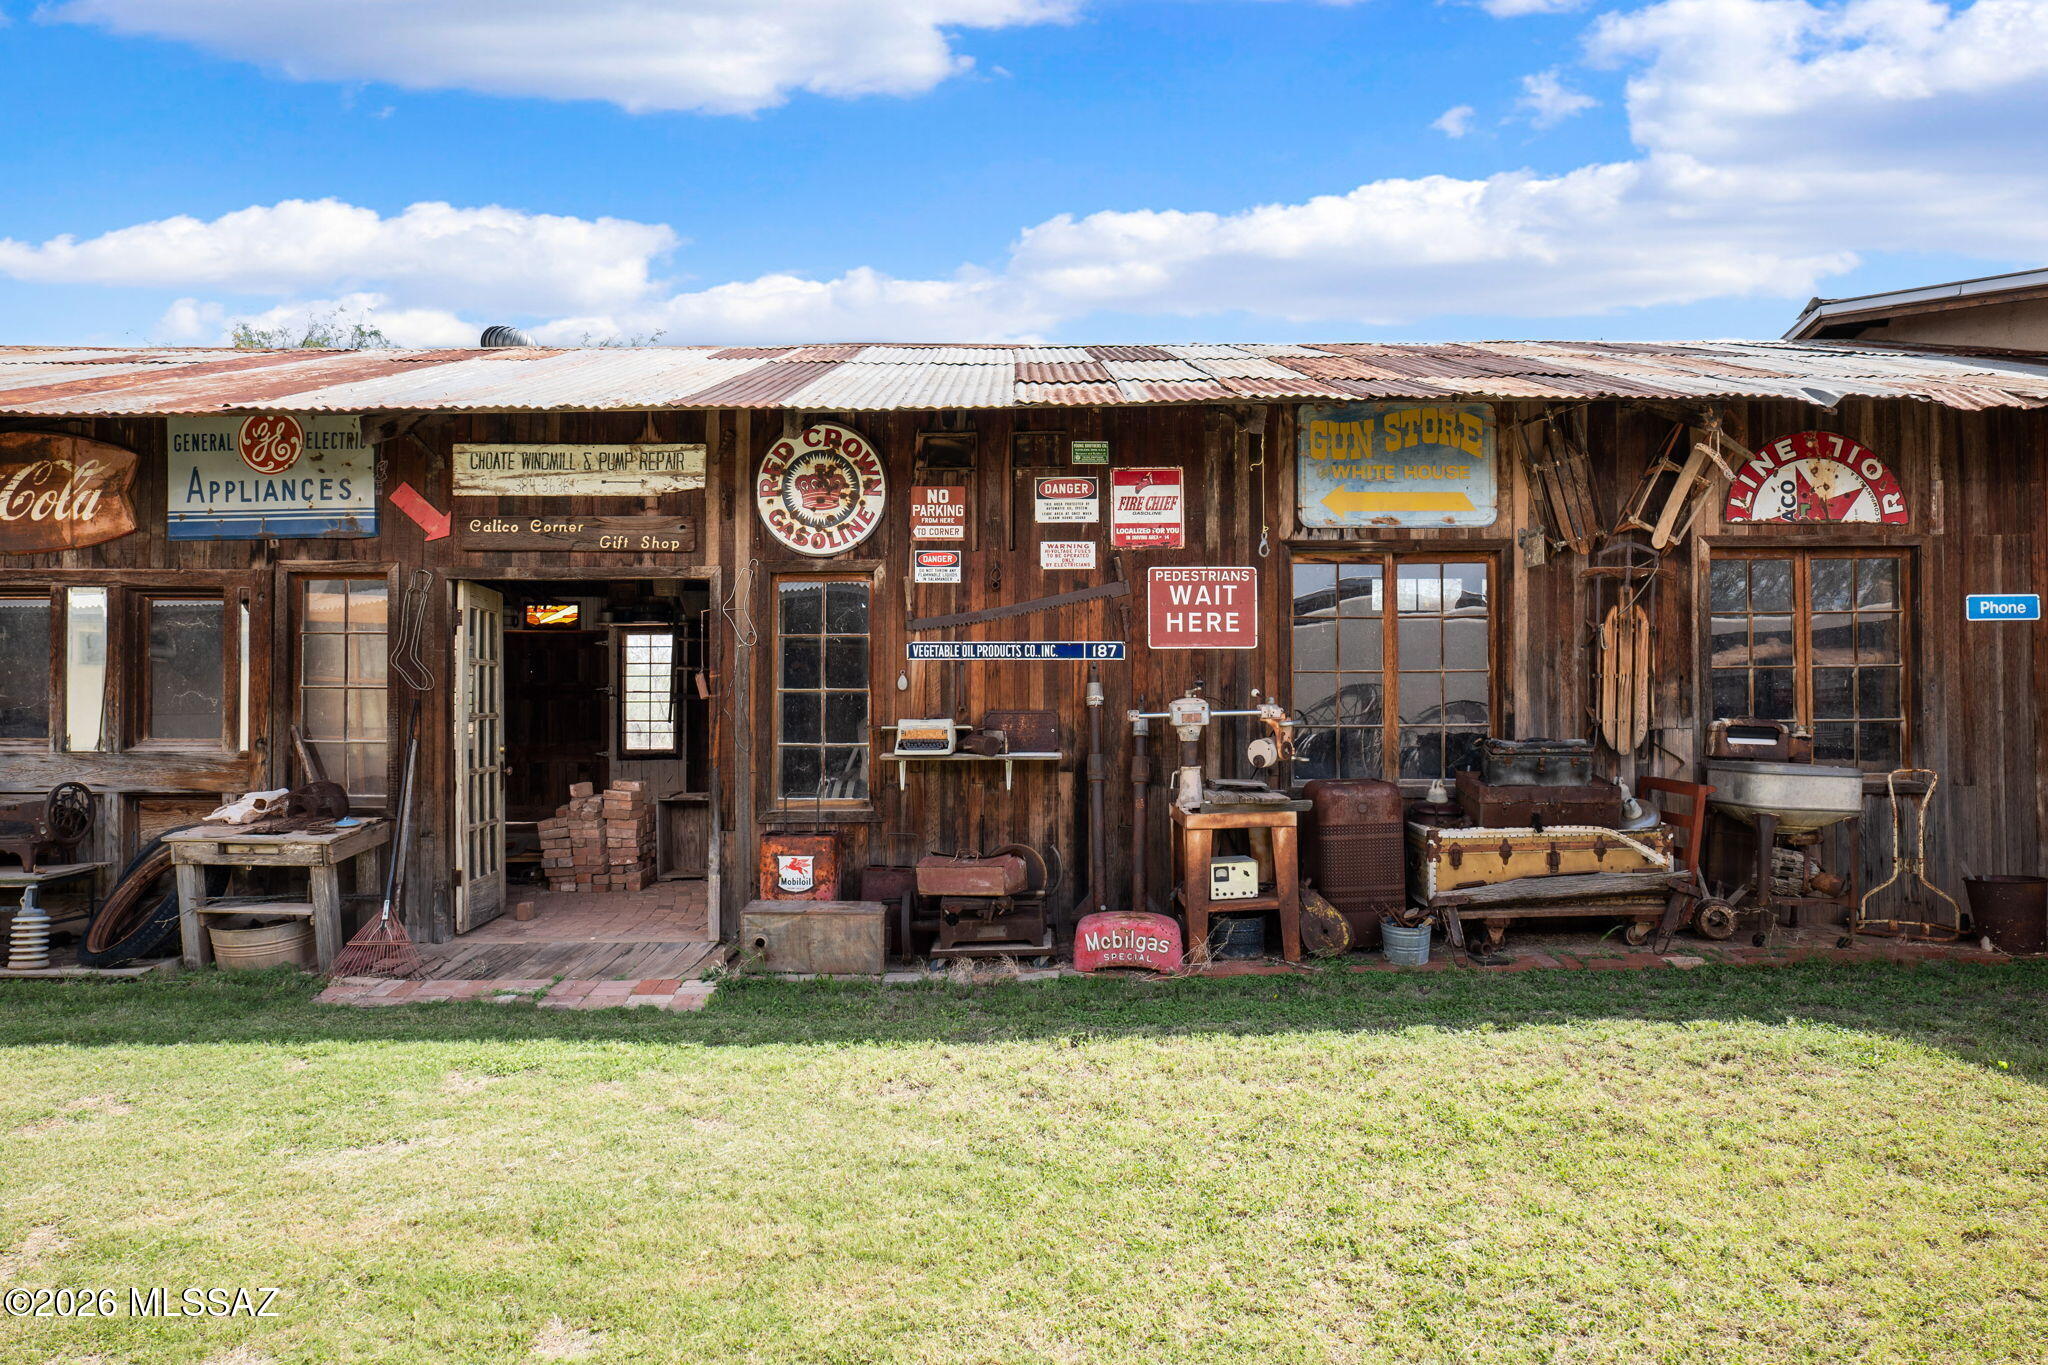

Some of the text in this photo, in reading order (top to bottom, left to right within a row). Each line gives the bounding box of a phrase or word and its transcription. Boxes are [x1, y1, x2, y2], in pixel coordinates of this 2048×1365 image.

[252, 421, 292, 462] GE
[1310, 407, 1484, 460] GUN STORE
[173, 432, 234, 452] GENERAL
[470, 451, 685, 471] CHOATE WINDMILL & PUMP REPAIR
[760, 428, 883, 498] RED CROWN
[1331, 464, 1471, 480] WHITE HOUSE
[1730, 438, 1797, 521] LINE
[186, 466, 352, 504] APPLIANCES
[1044, 483, 1089, 494] DANGER
[927, 488, 949, 504] NO
[1118, 495, 1179, 511] FIRE CHIEF
[912, 504, 964, 517] PARKING
[469, 519, 584, 533] Calico Corner
[769, 506, 876, 549] GASOLINE
[916, 528, 960, 536] TO CORNER
[1116, 527, 1151, 535] LOCALIZED
[600, 535, 680, 551] Gift Shop
[922, 555, 953, 563] DANGER
[1155, 570, 1250, 582] PEDESTRIANS
[1169, 584, 1238, 606] WAIT
[1980, 601, 2027, 614] Phone
[1166, 612, 1240, 633] HERE
[912, 644, 960, 658] VEGETABLE
[961, 644, 975, 658] OIL
[977, 644, 1022, 658] PRODUCTS
[1092, 645, 1117, 658] 187
[780, 877, 812, 886] Mobiloil
[1103, 953, 1153, 963] SPECIAL
